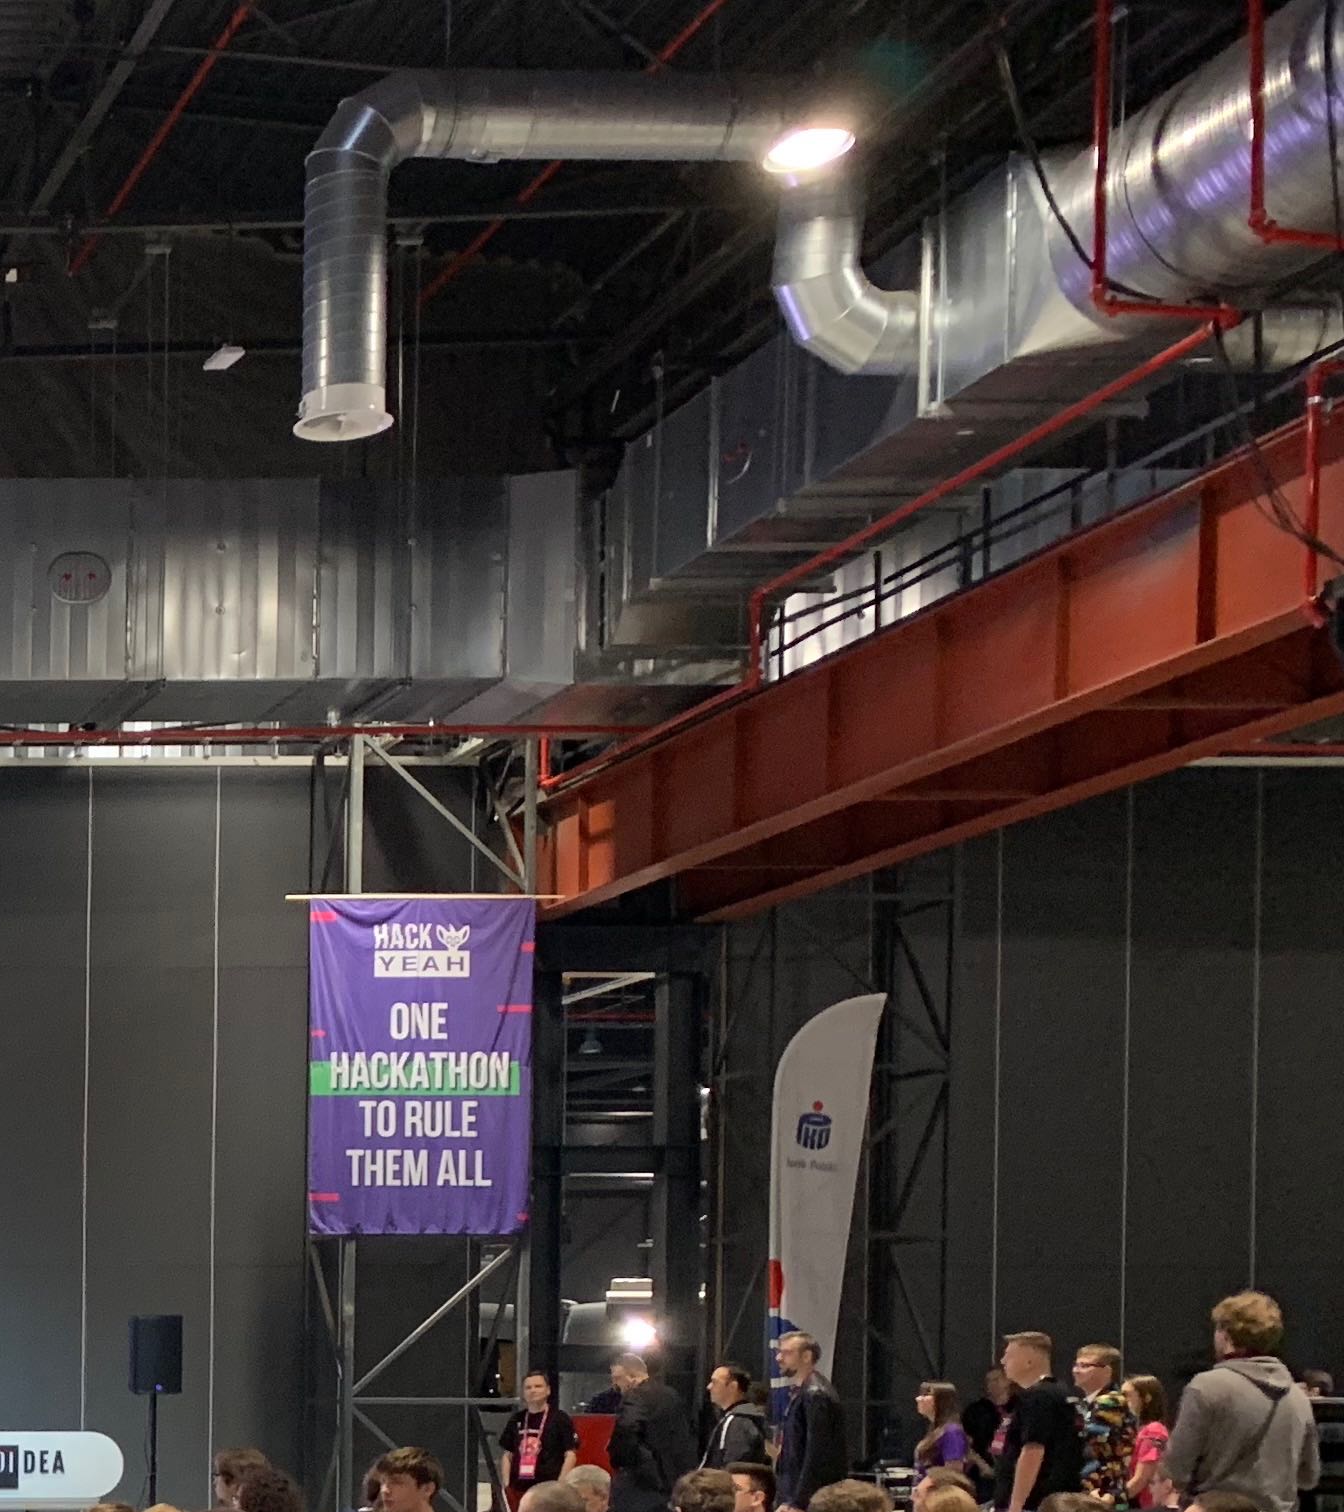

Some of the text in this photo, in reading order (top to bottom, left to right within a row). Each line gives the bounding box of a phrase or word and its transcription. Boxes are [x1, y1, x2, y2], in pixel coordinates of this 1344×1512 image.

[374, 923, 432, 949] HACK
[378, 955, 465, 972] YEAH
[390, 1002, 448, 1040] ONE
[329, 1051, 510, 1089] HACKATHON
[359, 1100, 479, 1138] TO RULE
[346, 1149, 493, 1187] THEM ALL
